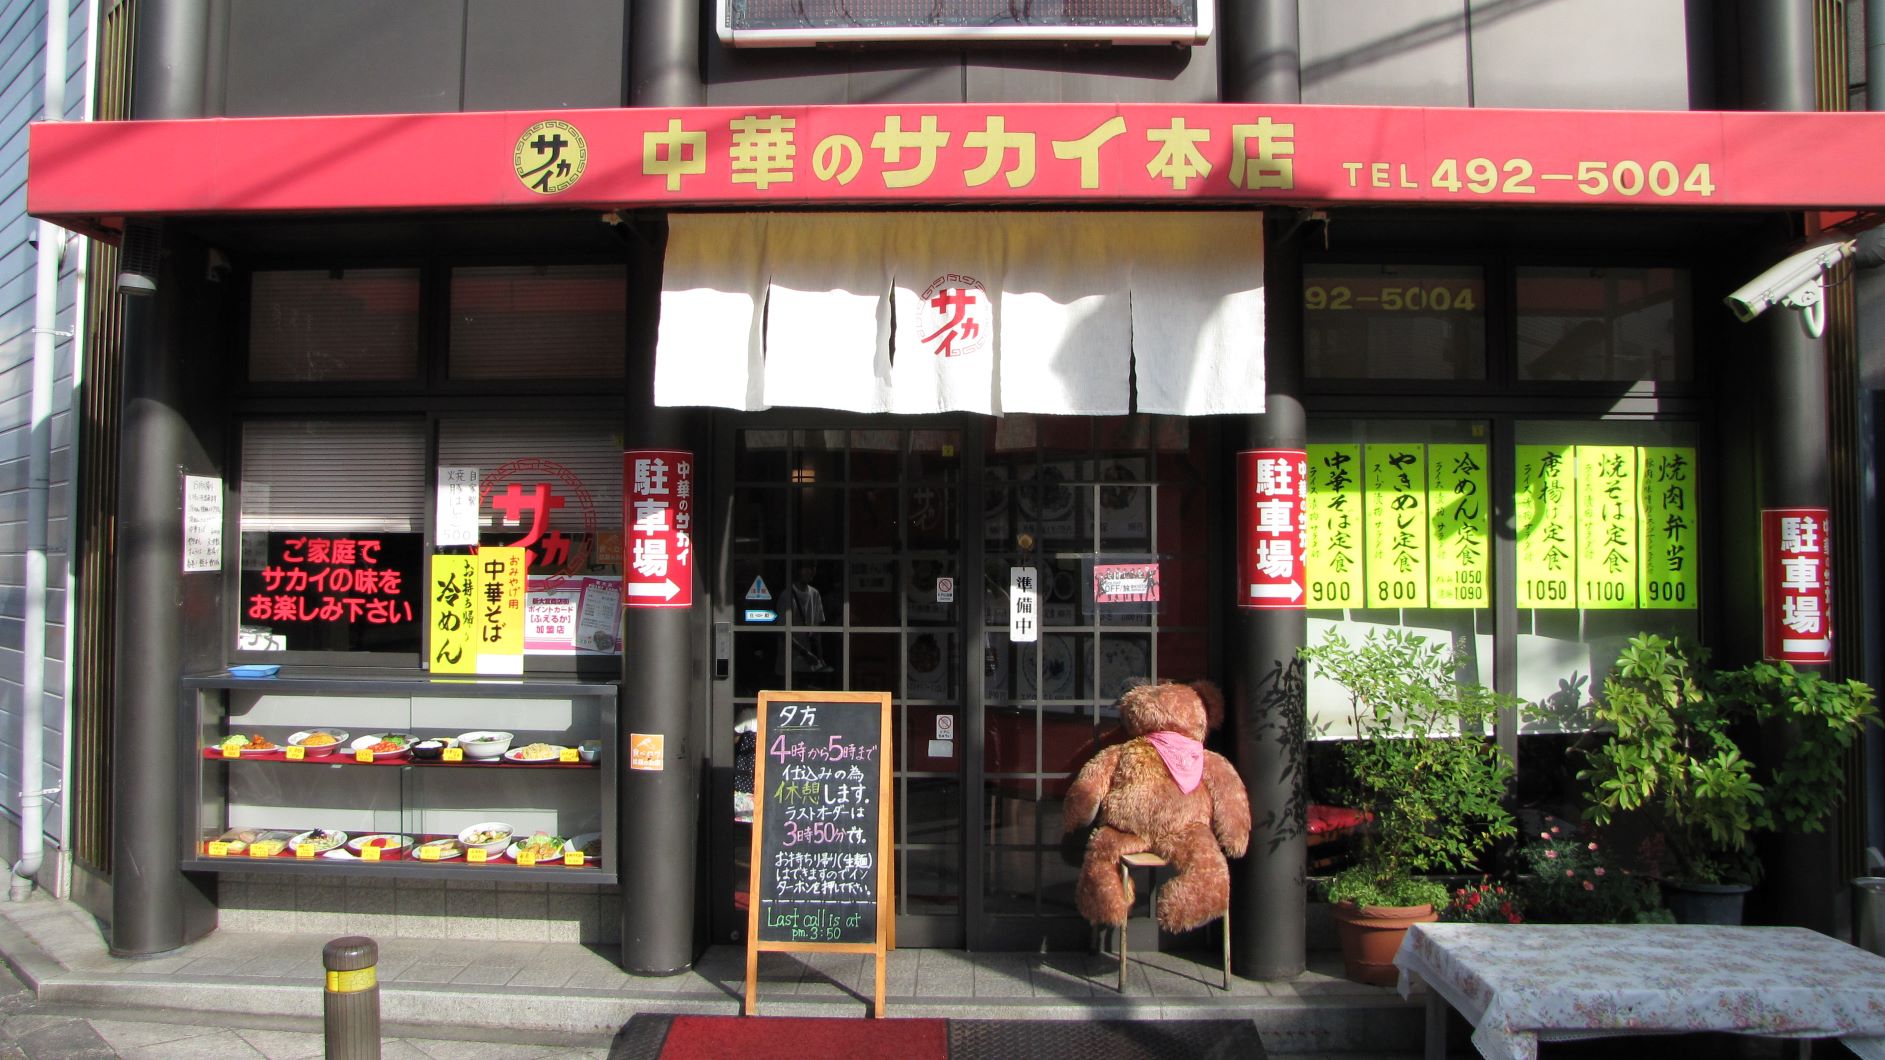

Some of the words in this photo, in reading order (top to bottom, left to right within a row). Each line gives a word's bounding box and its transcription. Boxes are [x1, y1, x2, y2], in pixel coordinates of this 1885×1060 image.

[521, 134, 570, 191] サカイ
[641, 115, 1295, 191] 中華のサカイ本店
[1343, 162, 1418, 189] TEL
[921, 288, 980, 358] サカイ
[633, 458, 670, 577] 駐車場
[676, 460, 690, 566] 中華のサカイ
[1256, 457, 1294, 578] 駐車場
[1388, 452, 1420, 573] やきめし定食
[1452, 452, 1482, 567] 冷めん定食
[1658, 454, 1688, 572] 焼肉弁当
[283, 537, 382, 564] ご家庭で
[262, 566, 402, 594] サカイの味を
[509, 555, 520, 609] おみやげ用
[1455, 570, 1482, 584] 1050
[1781, 516, 1820, 633] 駐車場
[483, 559, 506, 642] 中華そば
[1313, 581, 1350, 601] 900
[1378, 581, 1416, 601] 800
[1455, 586, 1482, 600] 1090
[1527, 580, 1567, 600] 1050
[1587, 582, 1625, 601] 1100
[1649, 581, 1686, 602] 900
[249, 594, 412, 623] お楽しみ下さい
[436, 572, 463, 664] 冷めん
[1015, 576, 1032, 635] 準備中
[536, 626, 565, 634] 加盟店
[780, 705, 817, 727] 夕方
[770, 734, 878, 764] 4時から5時まで
[782, 764, 865, 782] 仕込みの為
[785, 804, 865, 821] ラストオーダーは
[782, 821, 867, 847] 3時50分です。
[776, 867, 868, 881] はできますのでイン
[776, 880, 871, 897] ターホンを押して下さい。
[767, 907, 800, 927] Last
[803, 909, 826, 927] call
[829, 914, 841, 926] is
[846, 913, 861, 927] at
